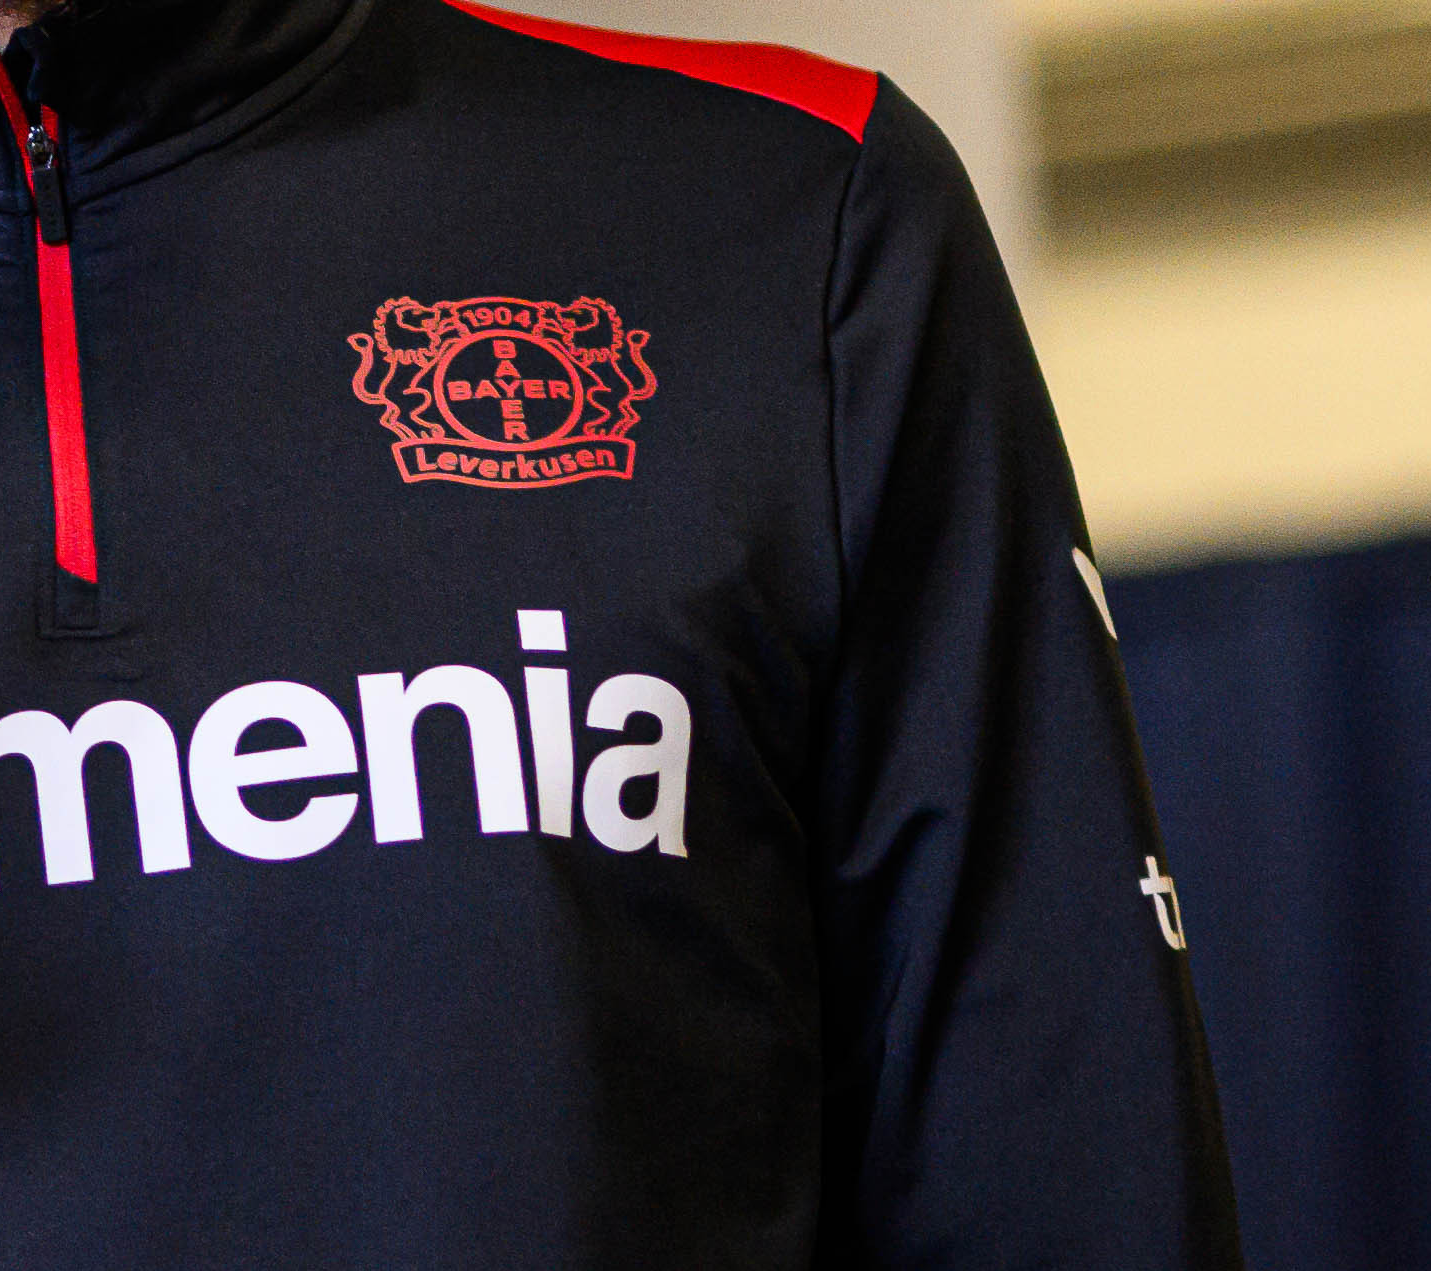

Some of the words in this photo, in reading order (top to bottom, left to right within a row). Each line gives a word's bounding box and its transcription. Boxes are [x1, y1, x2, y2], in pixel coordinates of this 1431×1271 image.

[464, 305, 532, 328] 1904
[447, 379, 572, 401] BAYER
[491, 339, 530, 441] BAYER
[415, 446, 617, 480] Leverkusen
